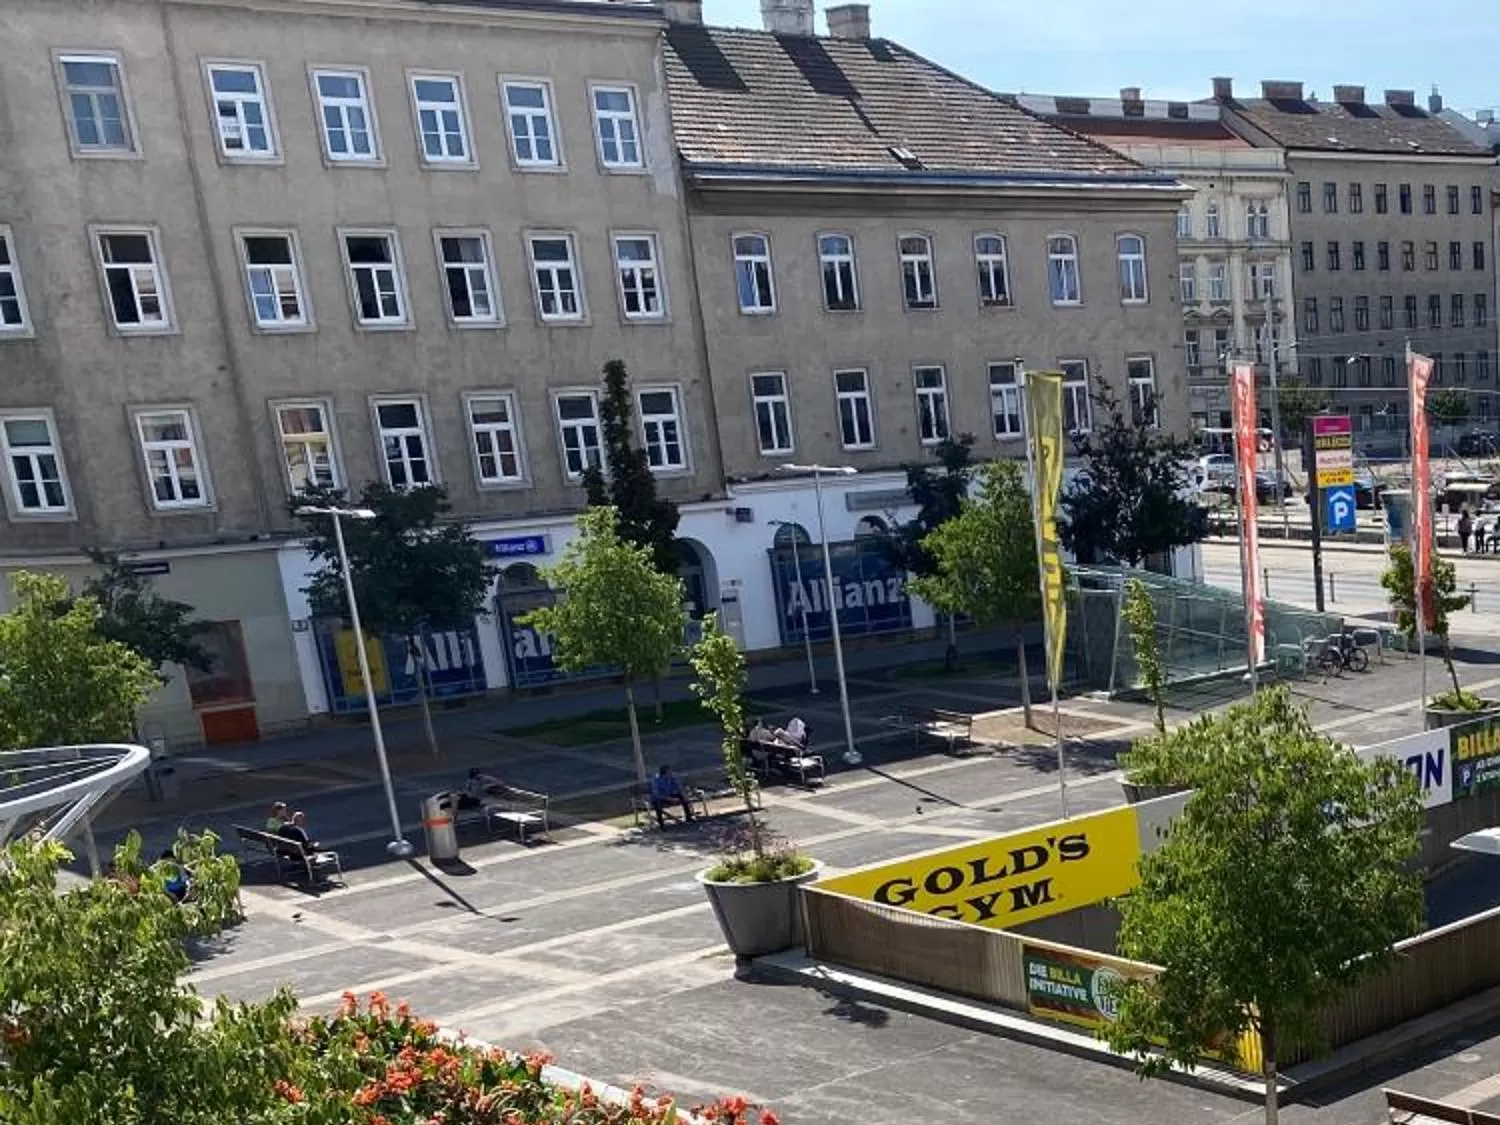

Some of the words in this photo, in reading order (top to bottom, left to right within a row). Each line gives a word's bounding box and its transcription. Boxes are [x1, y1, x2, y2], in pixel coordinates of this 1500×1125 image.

[1334, 501, 1349, 525] P
[787, 576, 906, 616] Allianz
[874, 833, 1090, 906] GOLD'S
[1029, 961, 1048, 980] DIE
[1049, 965, 1083, 986] BILLA
[1029, 977, 1090, 1003] INITIATIVE
